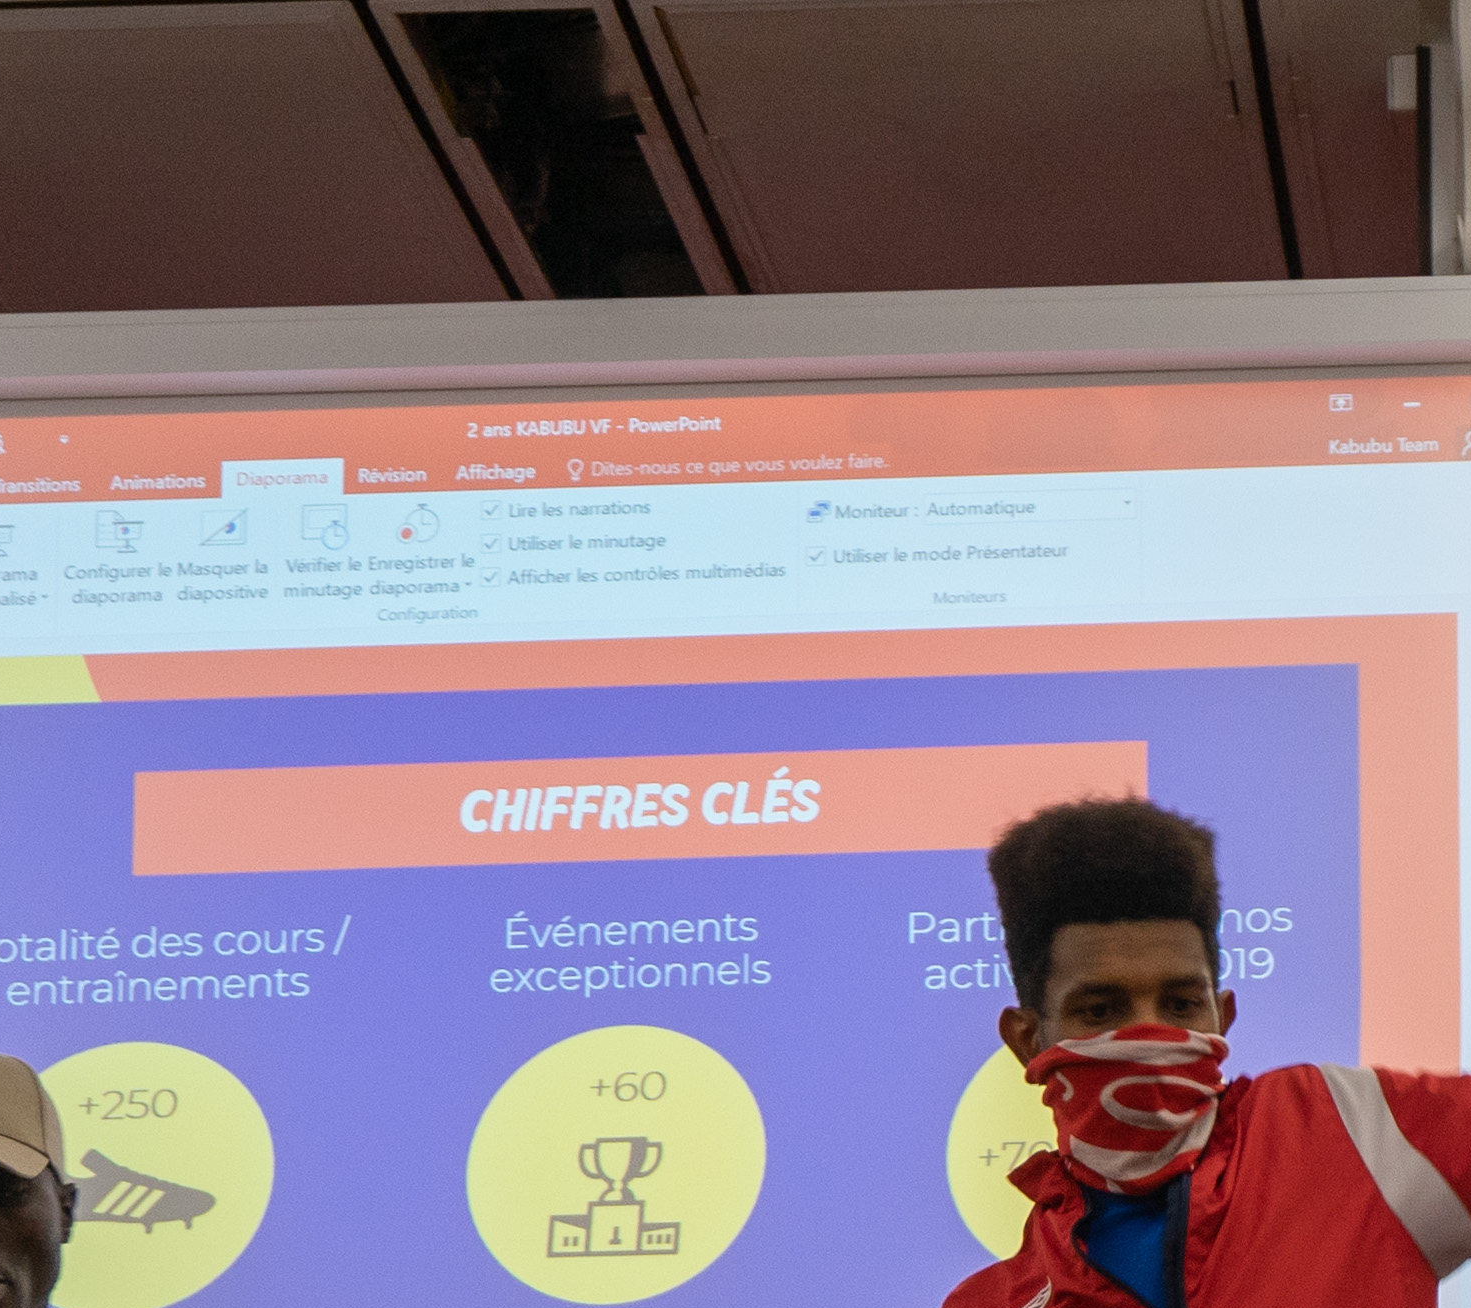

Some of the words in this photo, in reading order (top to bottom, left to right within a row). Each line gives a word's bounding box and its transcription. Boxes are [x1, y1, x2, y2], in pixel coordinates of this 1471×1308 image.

[468, 422, 478, 438] 2
[482, 423, 512, 437] ans
[515, 419, 587, 436] KABUBU
[590, 419, 611, 435] VF
[628, 416, 722, 433] PowerPoint
[1329, 438, 1393, 455] Kabubu
[1397, 437, 1439, 452] Team
[357, 467, 428, 483] Révision
[455, 464, 537, 483] Affichage
[590, 459, 681, 477] Dites-nous
[686, 462, 704, 474] ce
[708, 461, 741, 477] que
[744, 459, 785, 472] vous
[789, 457, 843, 471] voulez
[109, 474, 207, 491] Animations
[236, 471, 329, 489] Diaporama
[509, 504, 538, 519] Lire
[542, 502, 563, 517] les
[568, 500, 652, 517] narrations
[835, 503, 909, 520] Moniteur
[925, 500, 1036, 519] Automatique
[508, 535, 564, 552] Utiliser
[568, 535, 583, 550] le
[588, 533, 667, 552] minutage
[833, 547, 889, 564] Utiliser
[893, 546, 908, 562] le
[912, 545, 962, 561] mode
[966, 542, 1068, 560] Présentateur
[63, 562, 154, 583] Configurer
[158, 562, 172, 578] le
[177, 561, 249, 582] Masquer
[254, 560, 269, 575] la
[286, 558, 345, 575] Vérifier
[348, 557, 363, 572] le
[367, 554, 457, 576] Enregistrer
[460, 552, 475, 568] le
[507, 567, 570, 586] Afficher
[577, 567, 599, 583] les
[603, 564, 680, 582] contrôles
[684, 561, 786, 580] multimédias
[71, 586, 163, 606] diaporama
[177, 583, 269, 604] diapositive
[283, 580, 363, 600] minutage
[369, 577, 461, 600] diaporama
[932, 589, 1007, 604] Moniteurs
[376, 605, 479, 624] Configuration
[460, 783, 690, 833] CHIFFRES
[702, 765, 822, 825] CLÉS
[505, 910, 759, 949] Événements
[130, 925, 204, 959] des
[213, 922, 326, 957] cours
[489, 953, 771, 998] exceptionnels
[6, 966, 311, 1006] entraînements
[590, 1070, 667, 1102] +60
[78, 1088, 179, 1120] +250
